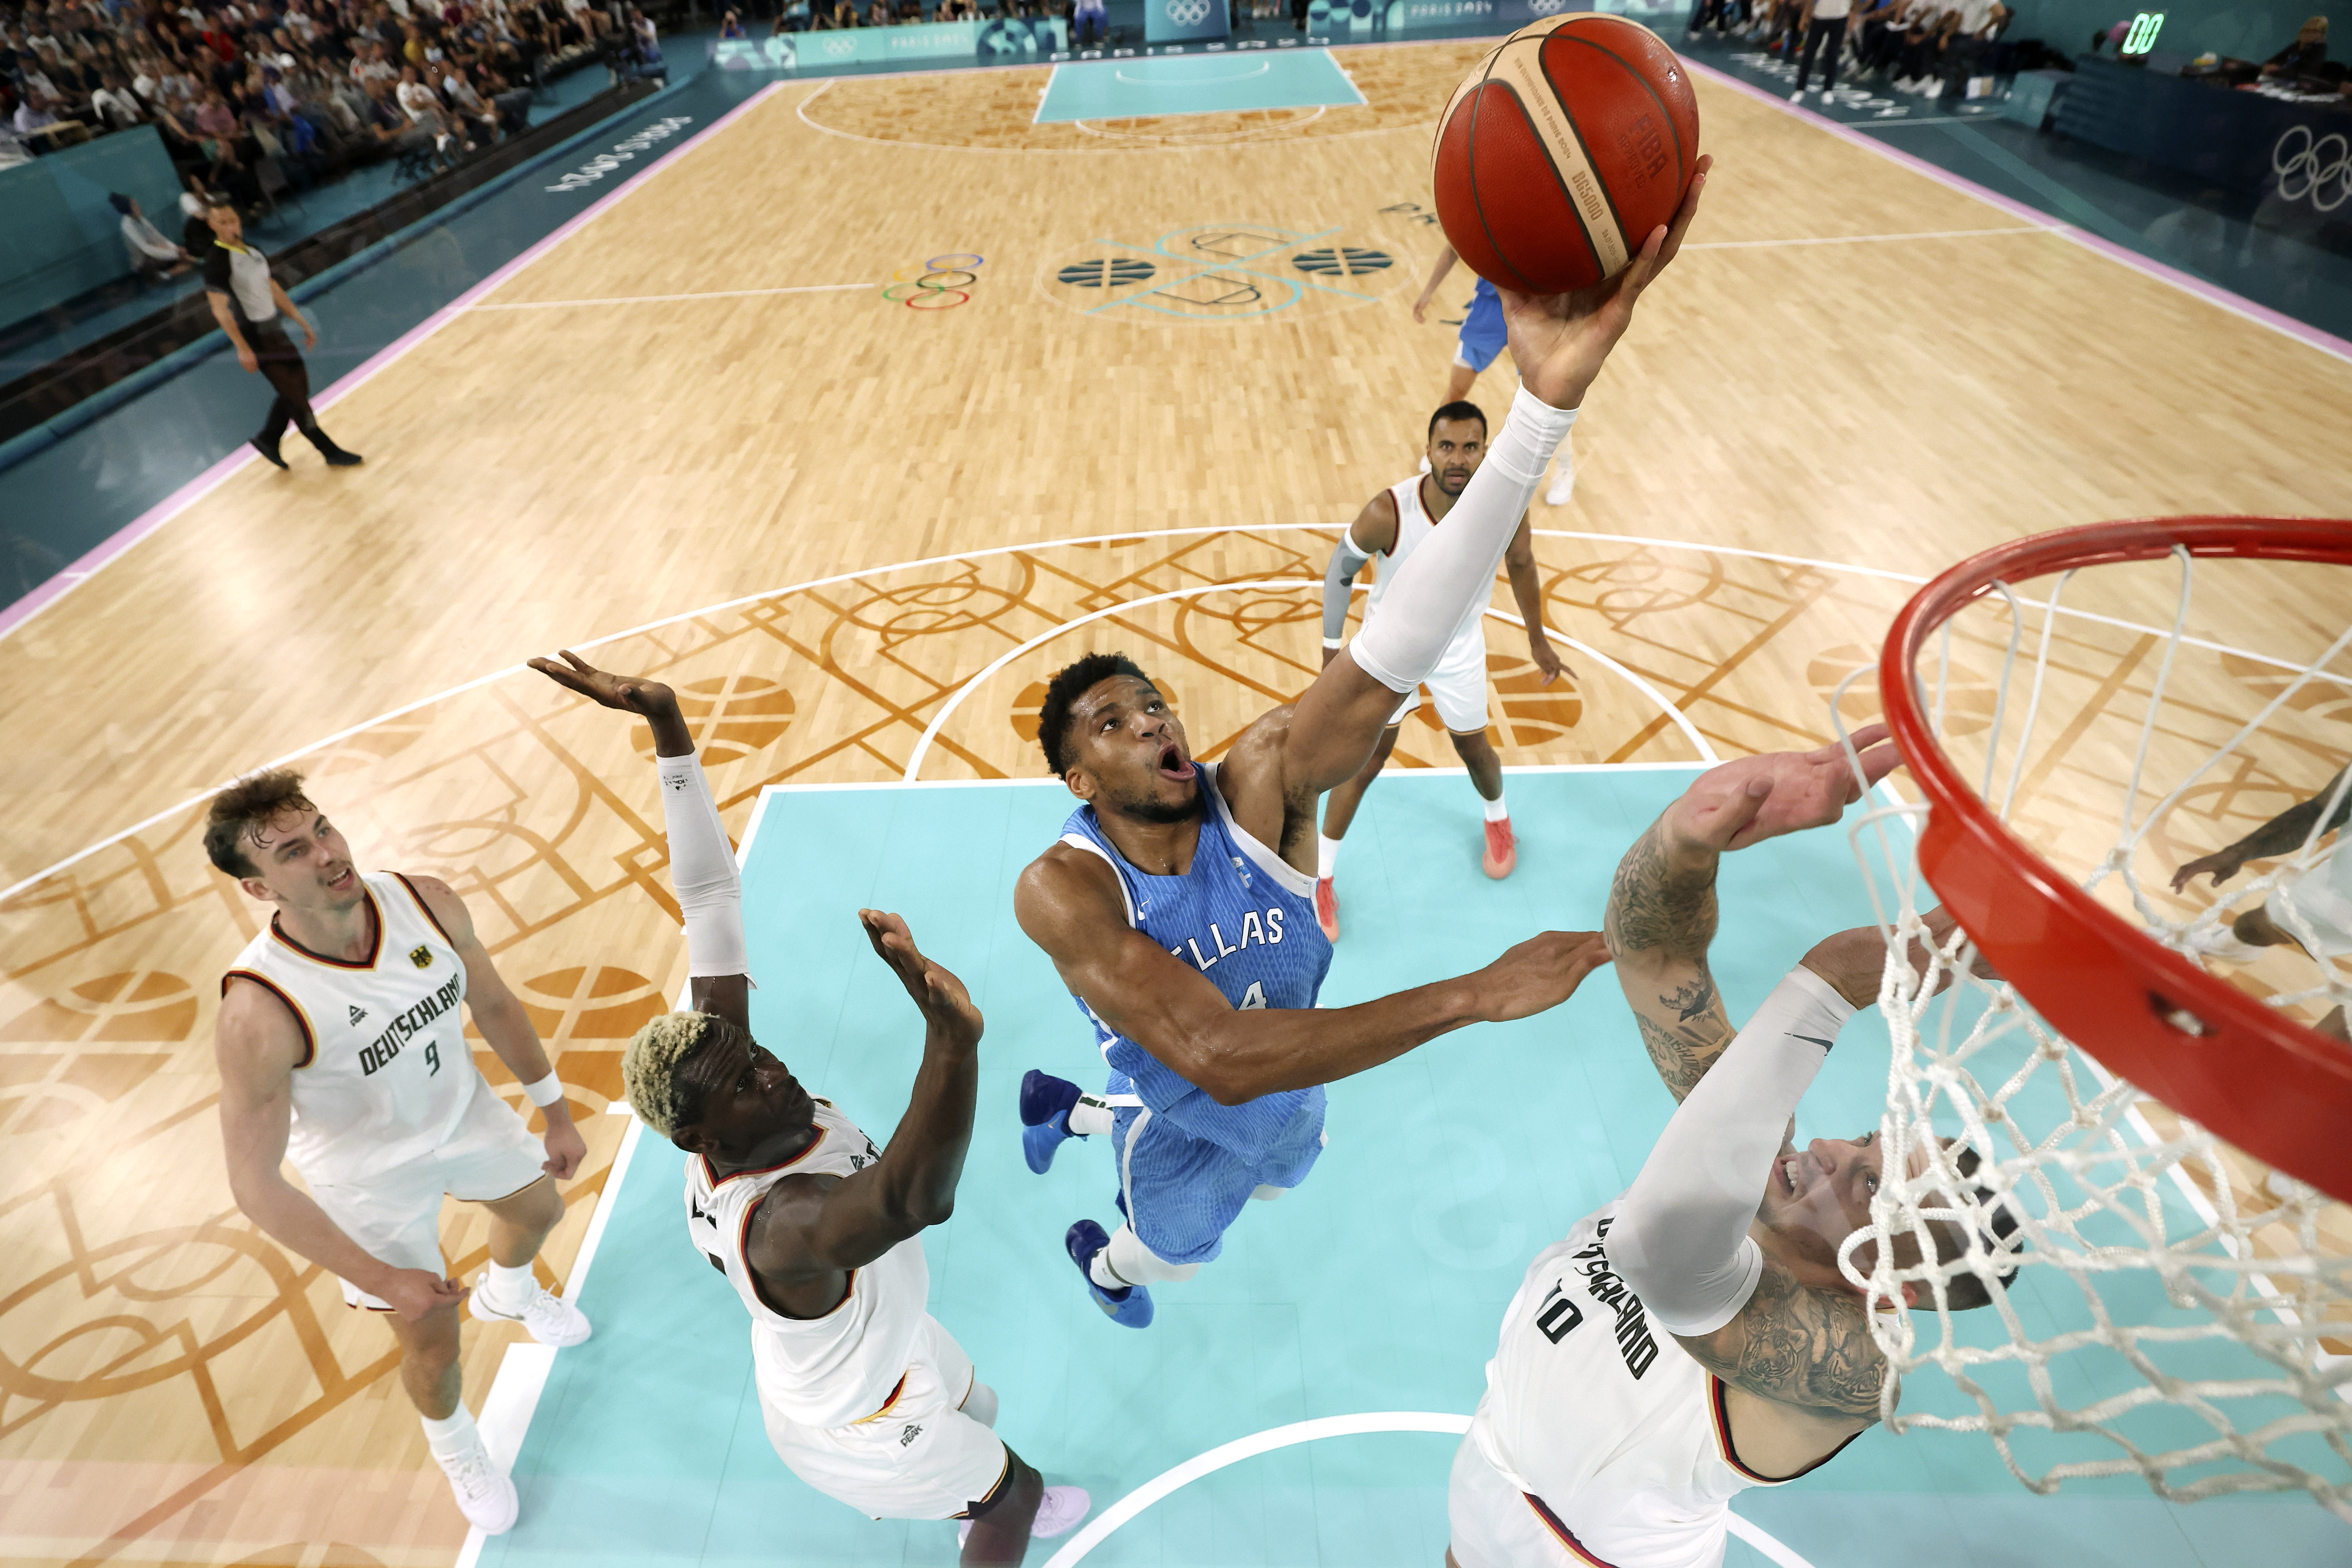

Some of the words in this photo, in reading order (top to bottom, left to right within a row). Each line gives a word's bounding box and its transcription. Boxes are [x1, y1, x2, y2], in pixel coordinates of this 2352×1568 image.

[2122, 13, 2164, 54] 00
[1631, 114, 1669, 180] FIBA
[424, 1040, 441, 1078] 9
[900, 1424, 924, 1447] PEAK
